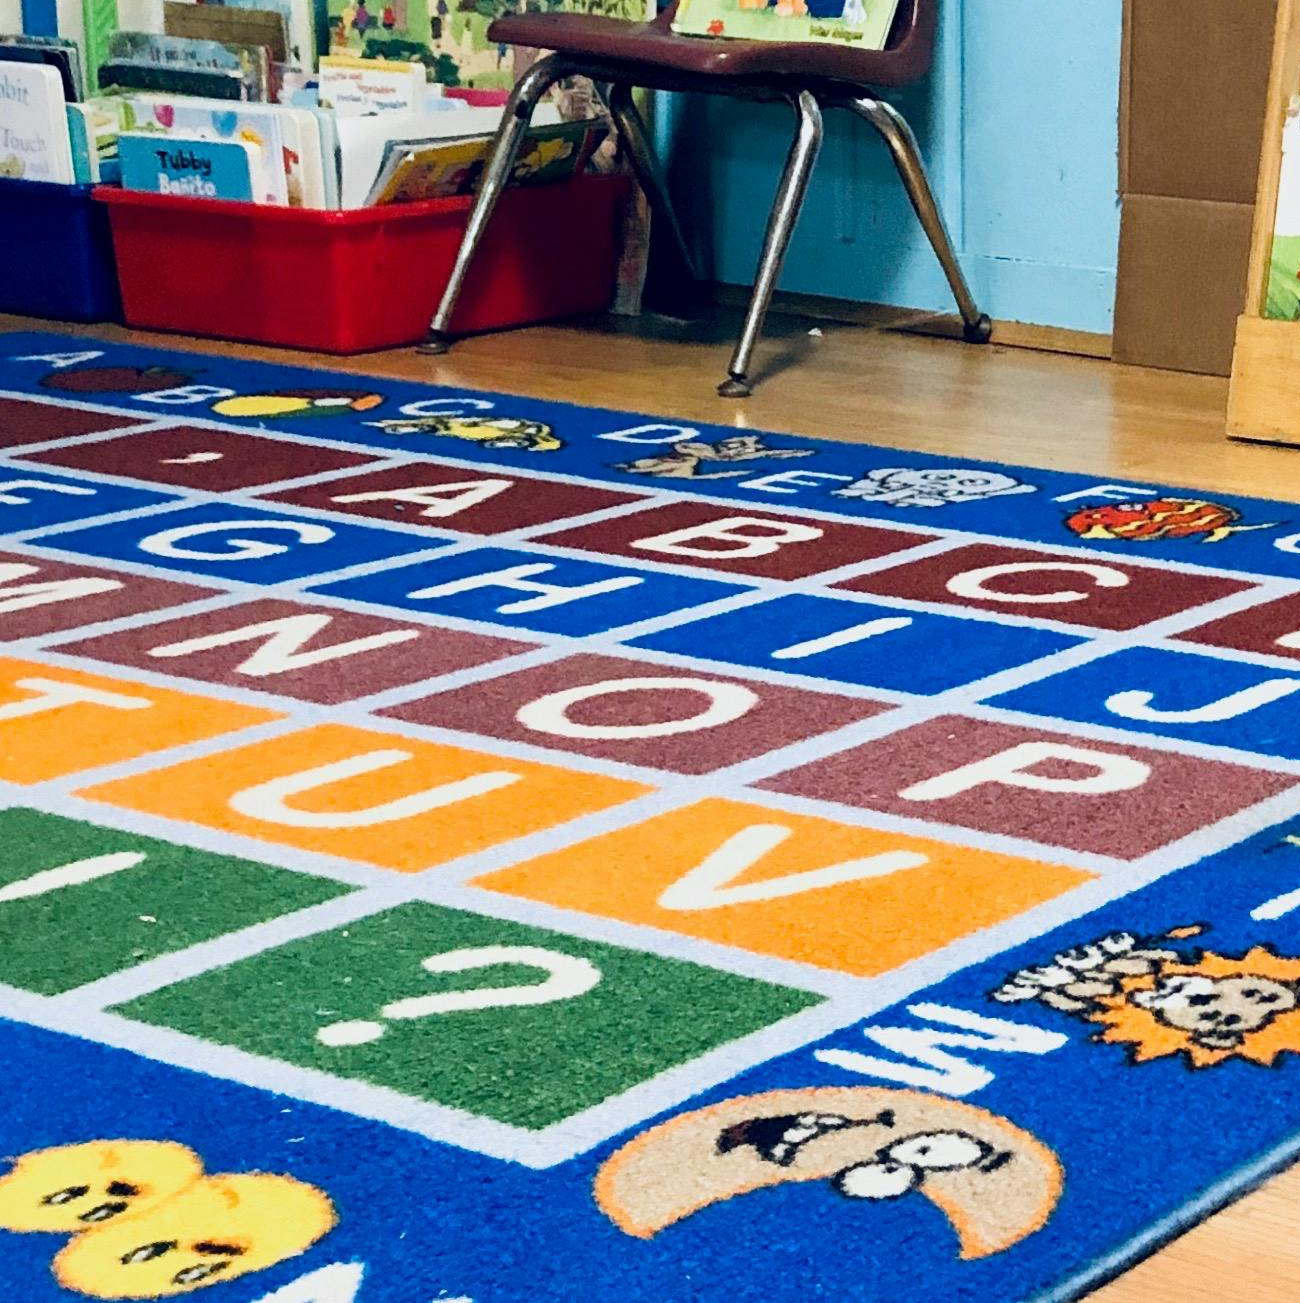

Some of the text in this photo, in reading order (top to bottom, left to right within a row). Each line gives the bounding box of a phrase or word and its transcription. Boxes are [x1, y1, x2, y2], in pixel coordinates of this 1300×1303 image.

[156, 150, 212, 176] Tubby
[17, 350, 105, 371] A
[131, 384, 236, 405] B
[399, 398, 495, 418] C
[596, 425, 700, 445] D
[739, 470, 854, 495] E
[1052, 485, 1158, 502] F
[331, 479, 514, 519] A
[629, 517, 824, 559] B
[946, 562, 1130, 602] C
[139, 520, 335, 562] G
[406, 563, 644, 614] H
[148, 613, 1152, 800] N O P
[230, 750, 522, 828] U
[658, 823, 931, 911] V
[316, 945, 601, 1047] ?
